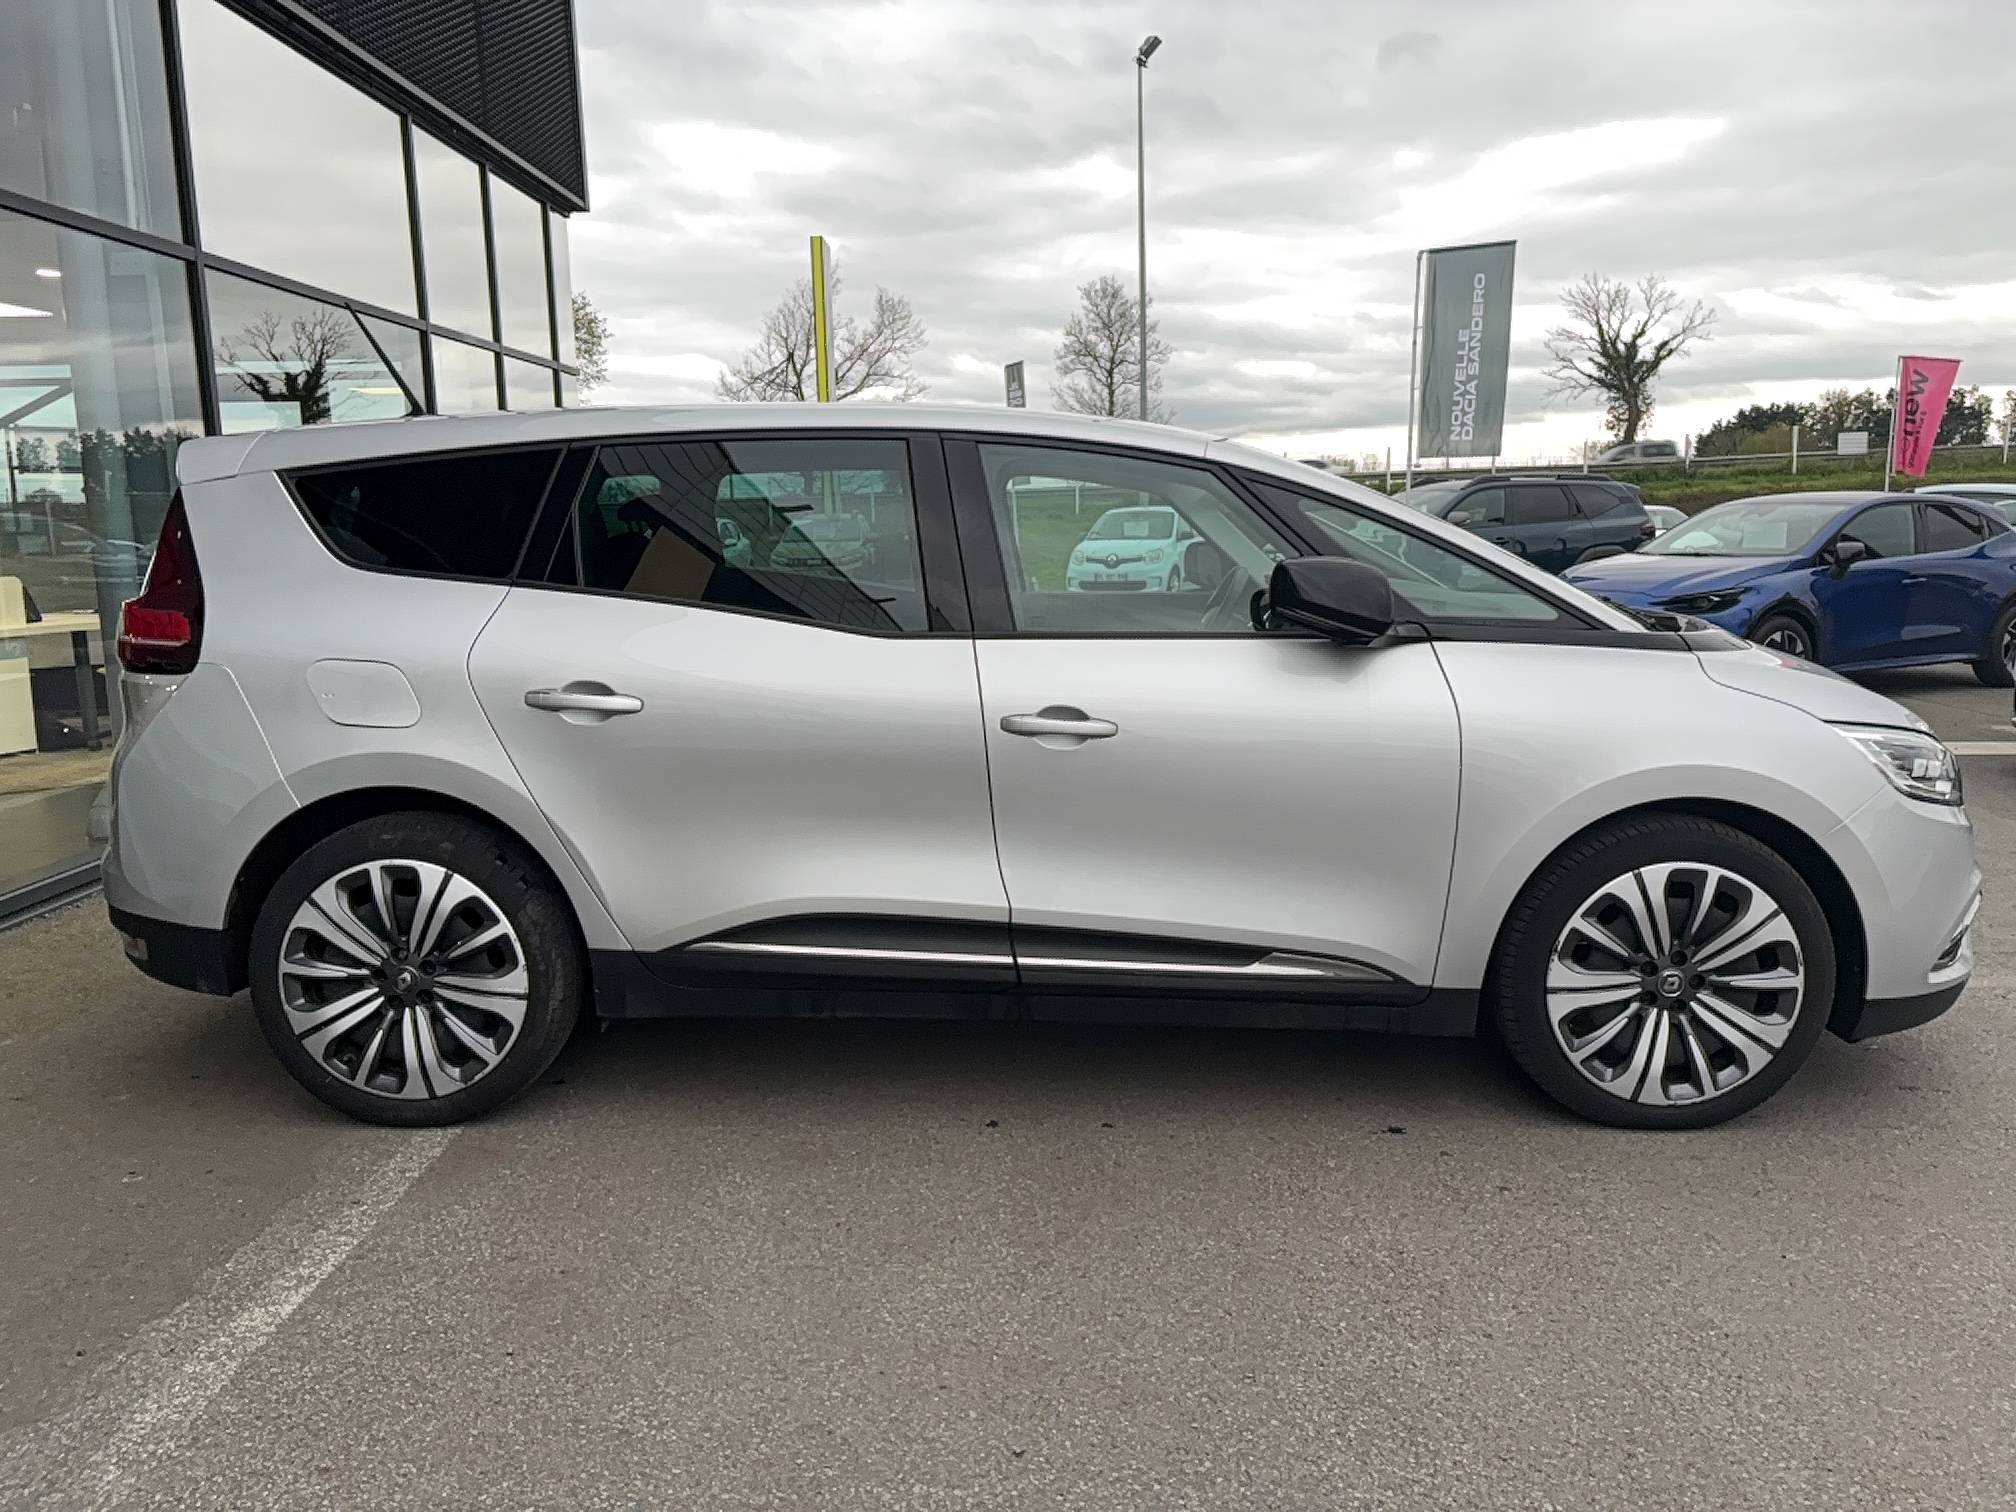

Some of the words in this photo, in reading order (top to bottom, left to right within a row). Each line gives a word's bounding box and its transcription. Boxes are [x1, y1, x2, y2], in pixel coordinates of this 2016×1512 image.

[1467, 273, 1486, 376] SANDERO
[1450, 328, 1470, 441] NOUVELLE
[1461, 379, 1479, 441] DACIA
